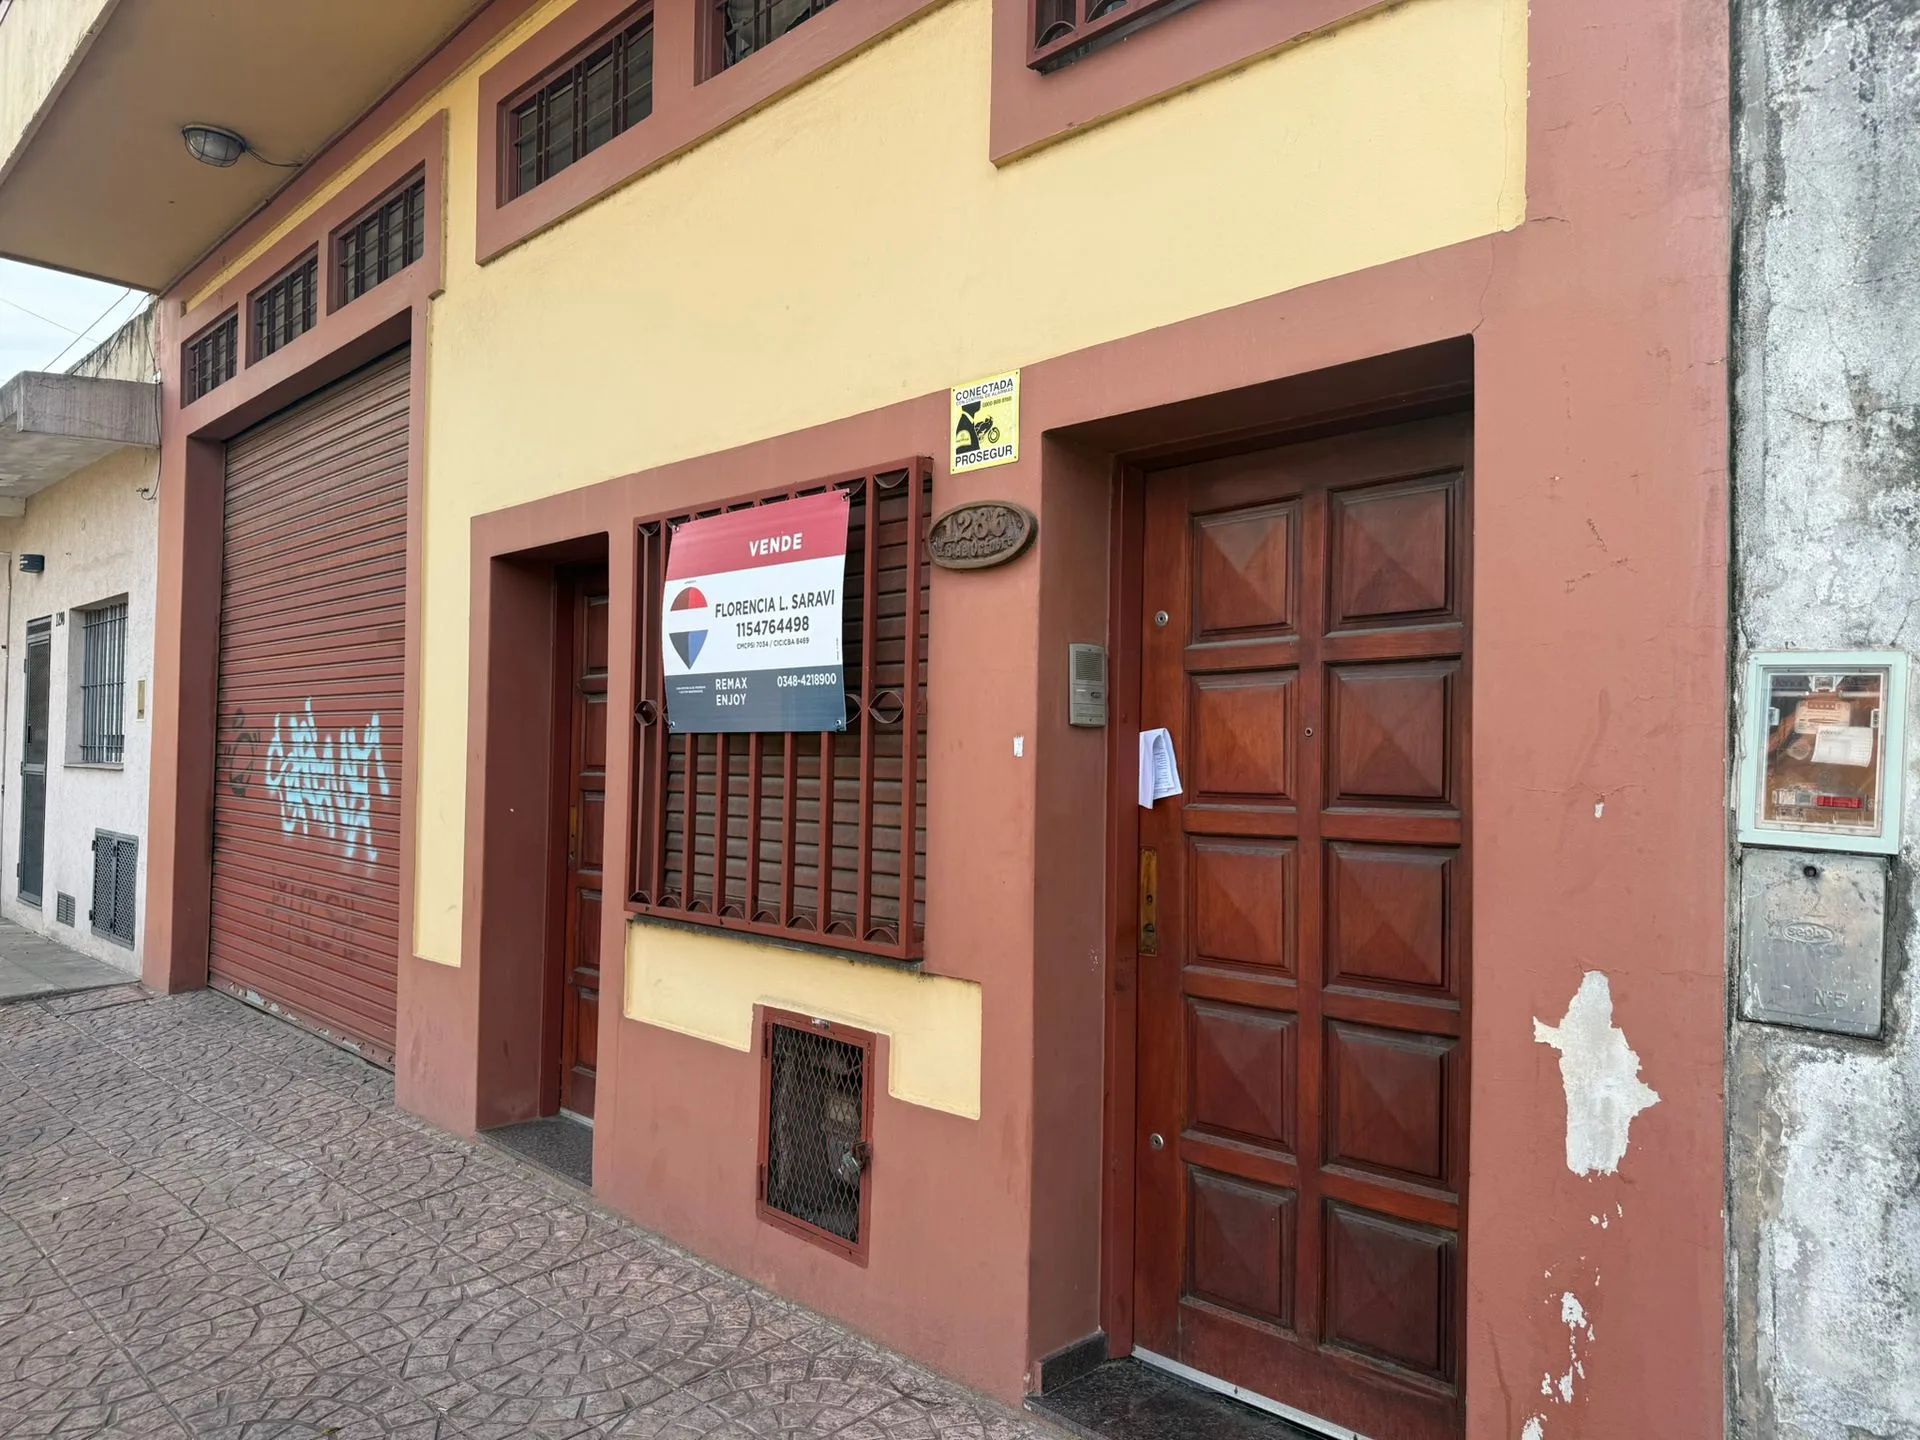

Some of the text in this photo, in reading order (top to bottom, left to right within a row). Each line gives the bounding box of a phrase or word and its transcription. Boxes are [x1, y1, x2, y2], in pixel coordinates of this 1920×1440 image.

[955, 378, 1014, 402] CONECTADA
[955, 444, 1013, 467] PROSEGUR
[942, 507, 1006, 541] 1286
[749, 532, 803, 557] VENDE
[715, 589, 835, 618] FLORENCIA L. SARAVI
[736, 615, 809, 637] 1154764498
[715, 677, 748, 691] REMAX
[777, 672, 837, 688] 0348-4218900
[716, 693, 747, 706] ENJOY
